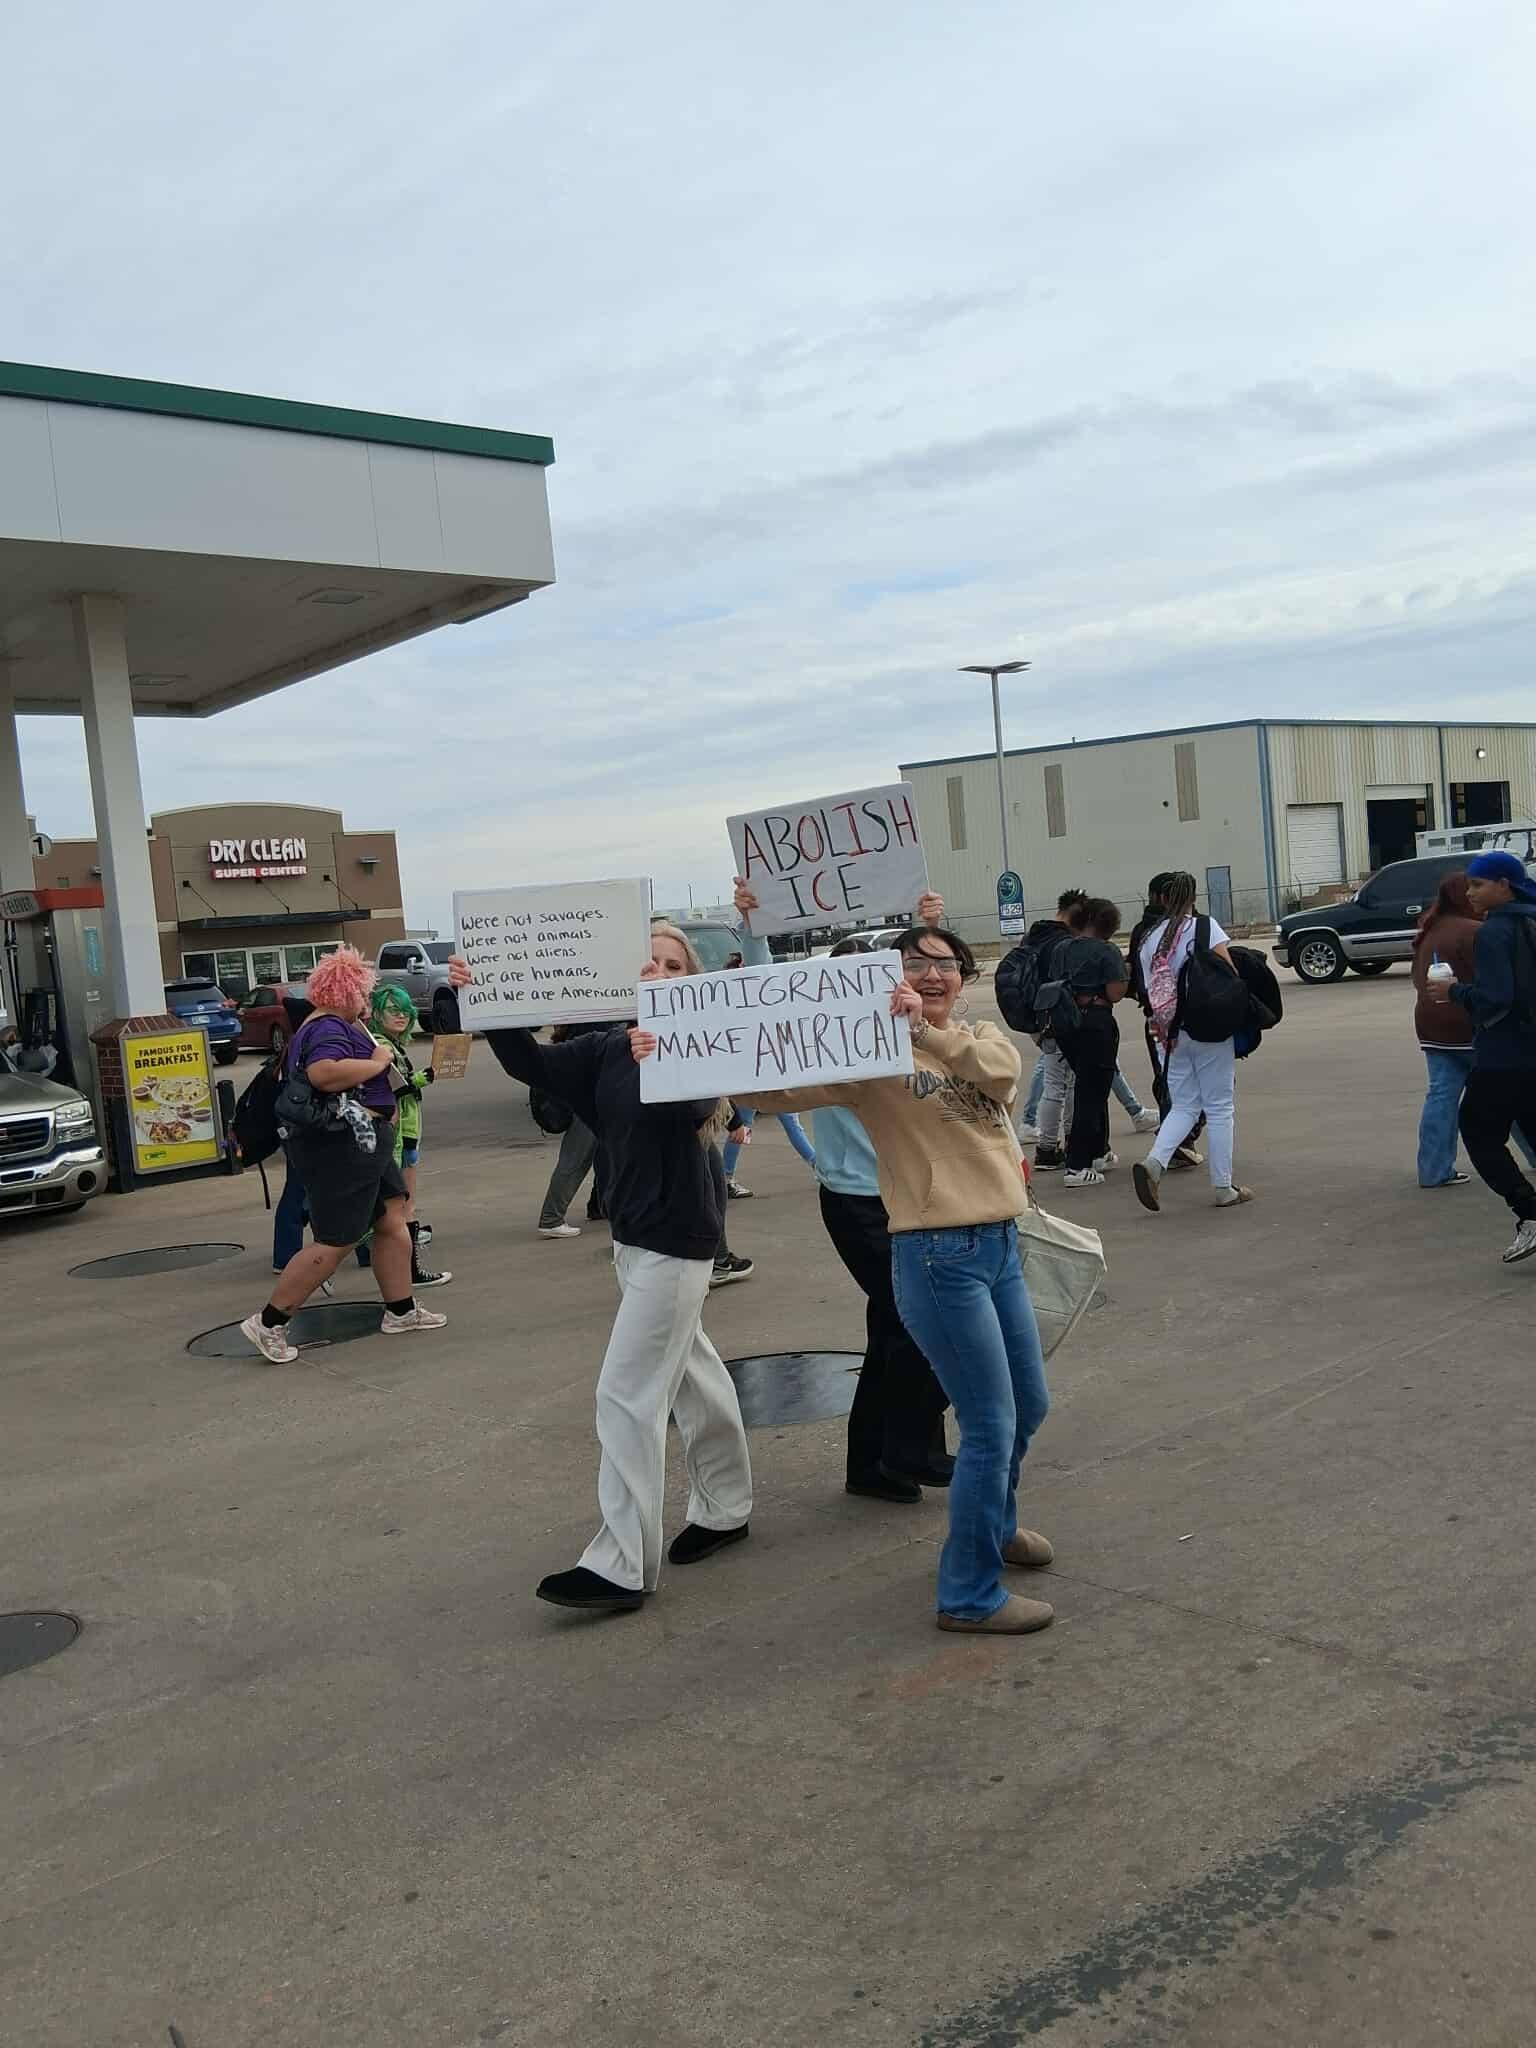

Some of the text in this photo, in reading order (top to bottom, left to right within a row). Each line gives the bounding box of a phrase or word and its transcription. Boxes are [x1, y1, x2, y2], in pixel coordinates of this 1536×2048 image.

[33, 836, 44, 855] 1
[743, 795, 918, 879] ABOLISH
[209, 838, 307, 864] DRY CLEAN
[215, 866, 307, 878] SUPER CENTER
[777, 862, 865, 920] ICE
[461, 909, 609, 931] Were not savages.
[462, 936, 497, 949] Were
[503, 932, 529, 945] not
[467, 947, 583, 966] Were not aliens.
[471, 965, 599, 986] We are humans,
[468, 988, 498, 1006] and
[503, 988, 525, 1001] we
[531, 988, 555, 1000] are
[644, 964, 898, 1019] IMMIGRANTS
[139, 1044, 193, 1057] FAMOUS FOR
[657, 1008, 899, 1077] MAKE AMERICA!
[135, 1053, 200, 1069] BREAKFAST
